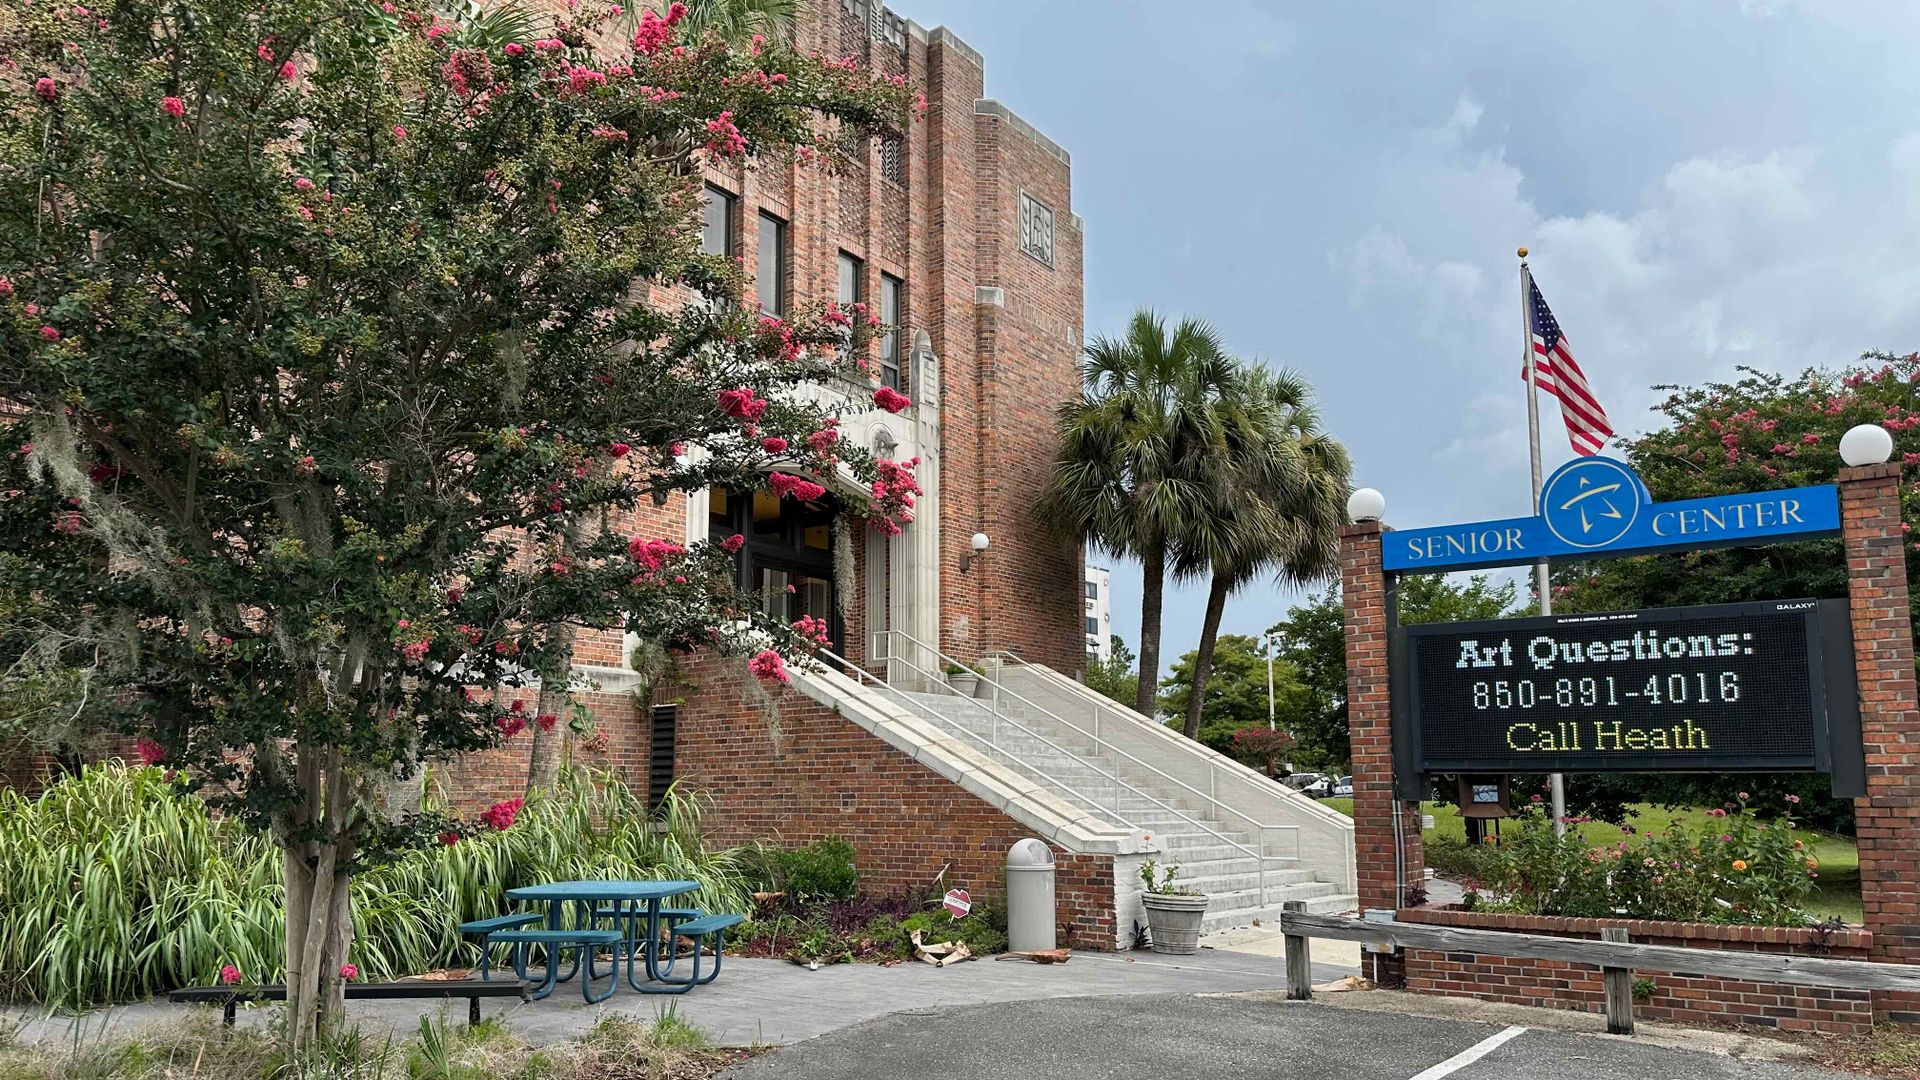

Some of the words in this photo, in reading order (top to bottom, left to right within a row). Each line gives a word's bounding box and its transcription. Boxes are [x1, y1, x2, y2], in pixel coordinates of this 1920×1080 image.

[1408, 528, 1525, 560] SENIOR
[1652, 500, 1805, 537] CENTER
[1776, 602, 1814, 610] GALAXY
[1456, 638, 1513, 668] Art
[1528, 630, 1753, 670] Questions:
[1474, 672, 1739, 709] 850-891-4016
[1506, 722, 1581, 751] Call
[1594, 719, 1710, 750] Heath
